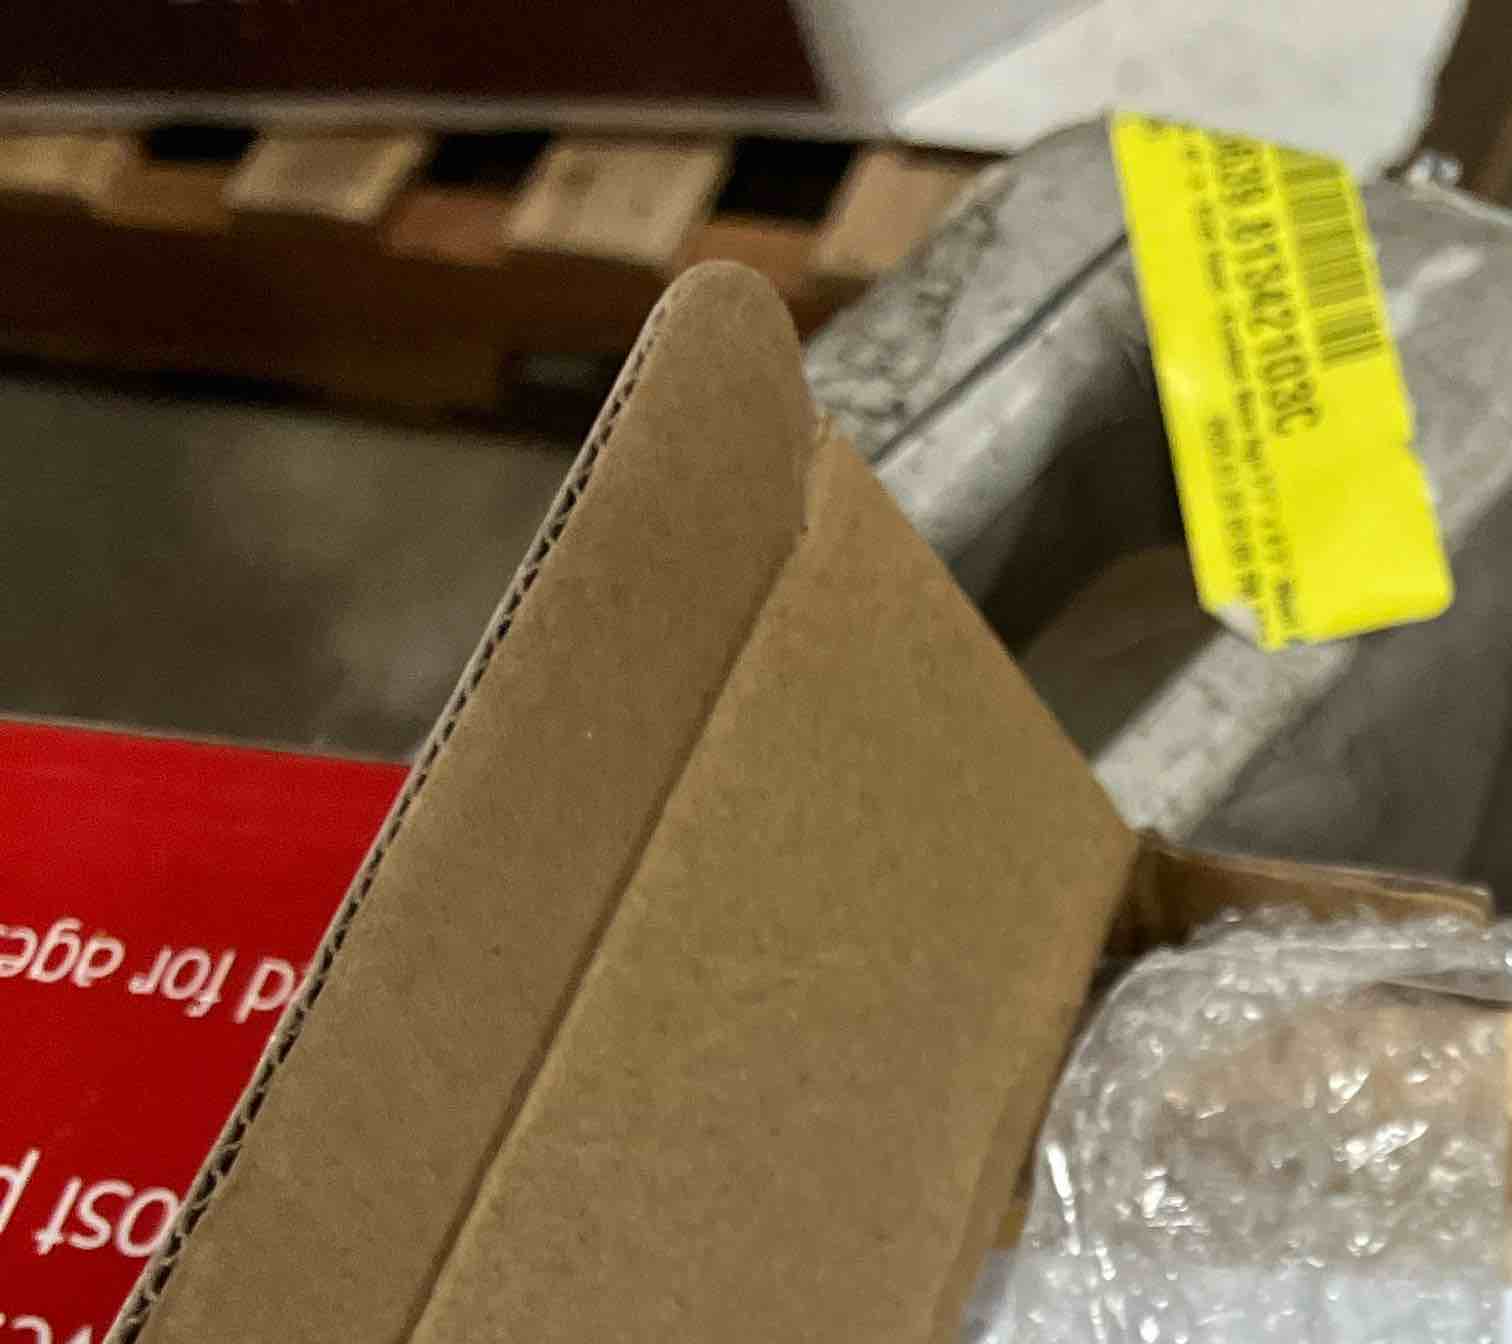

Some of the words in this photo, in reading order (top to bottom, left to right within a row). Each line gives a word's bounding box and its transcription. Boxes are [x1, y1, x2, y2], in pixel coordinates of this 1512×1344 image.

[129, 946, 237, 1018] for
[232, 957, 312, 1024] d
[33, 1176, 183, 1260] ost
